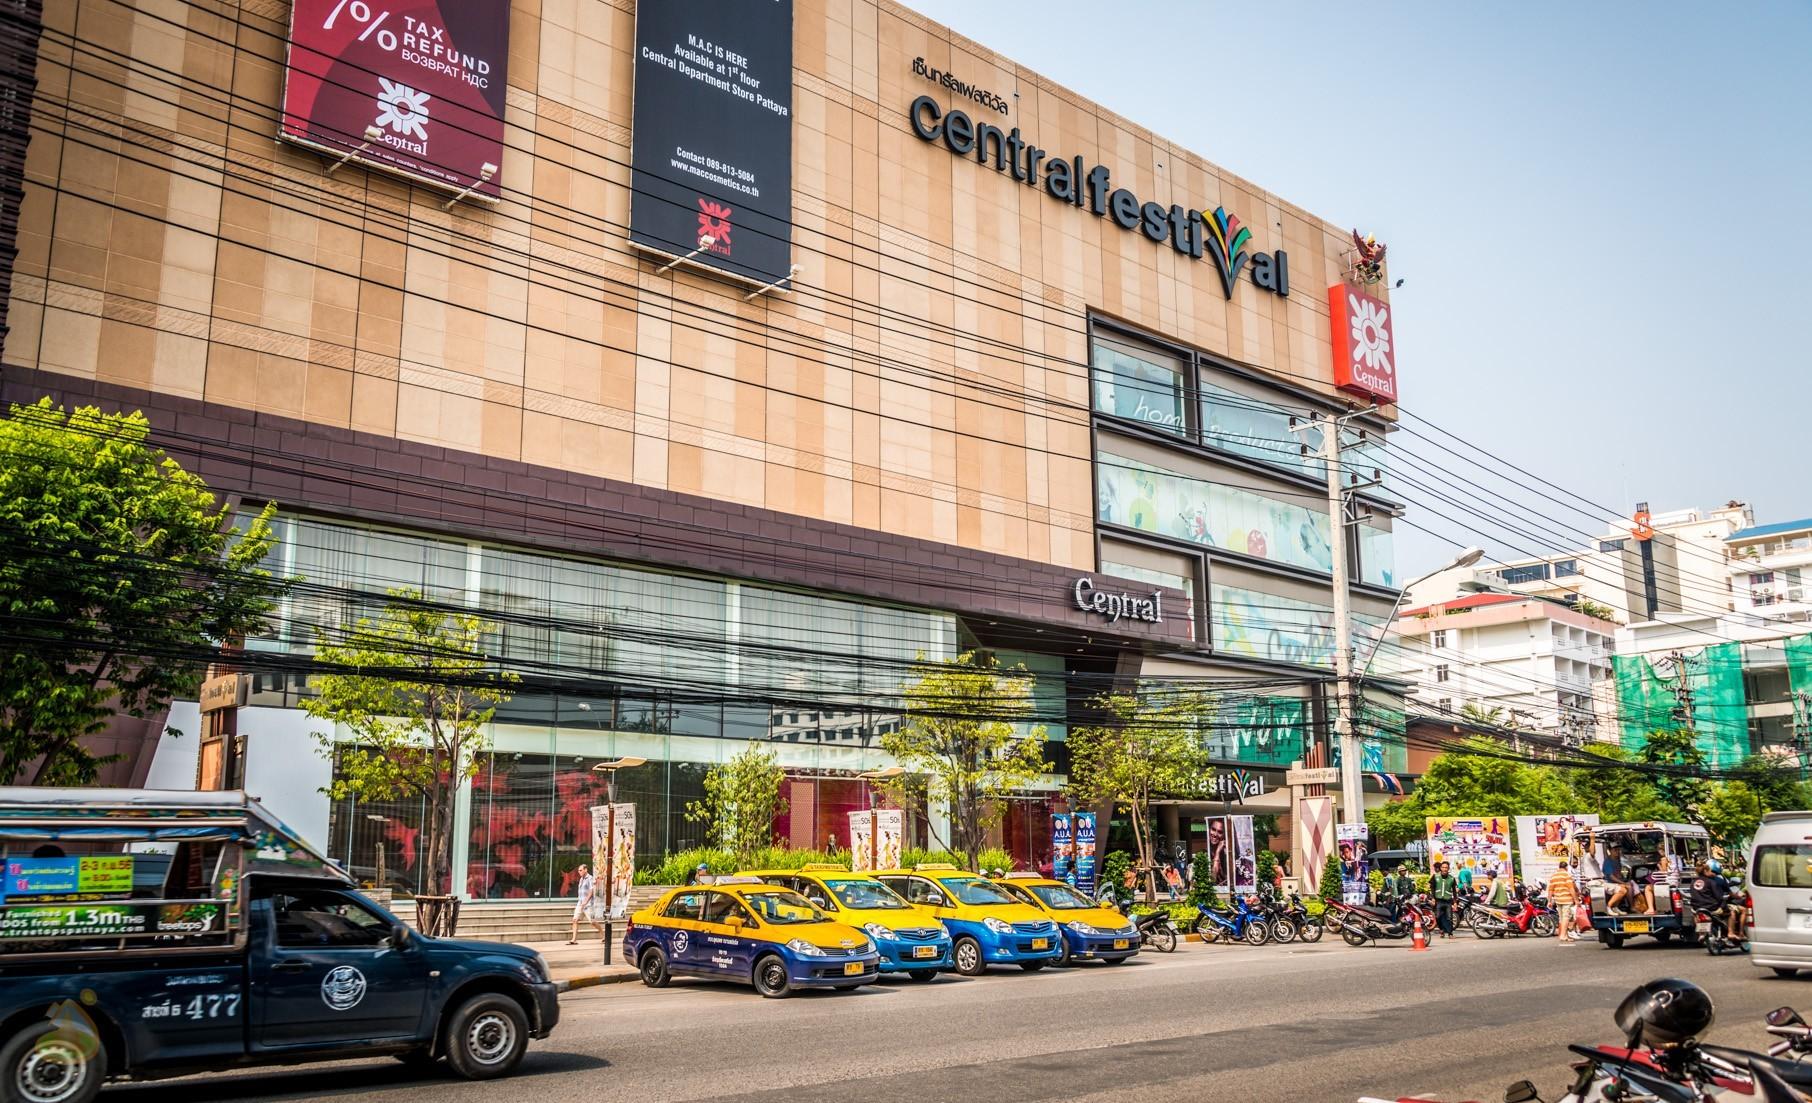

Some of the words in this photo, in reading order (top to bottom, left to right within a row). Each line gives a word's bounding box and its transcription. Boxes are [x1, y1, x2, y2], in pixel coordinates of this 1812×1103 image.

[404, 16, 443, 43] TAX
[401, 48, 460, 78] ВОЗВРАТ
[461, 70, 489, 89] НДС
[403, 32, 490, 75] REFUND
[674, 44, 714, 70] Available
[716, 63, 726, 75] at
[740, 71, 761, 89] floor
[688, 34, 713, 54] M.A.C
[715, 45, 724, 59] IS
[726, 49, 748, 70] HERE
[642, 47, 677, 70] Central
[679, 61, 731, 93] Department
[732, 83, 755, 102] Store
[756, 93, 788, 117] Pattaya
[676, 146, 705, 165] Contact
[670, 158, 760, 198] www.maccosmetics.co.th
[1353, 363, 1394, 395] Central
[1074, 577, 1164, 624] Central
[0, 919, 29, 929] DOS
[30, 918, 62, 927] from
[185, 993, 242, 1020] 477
